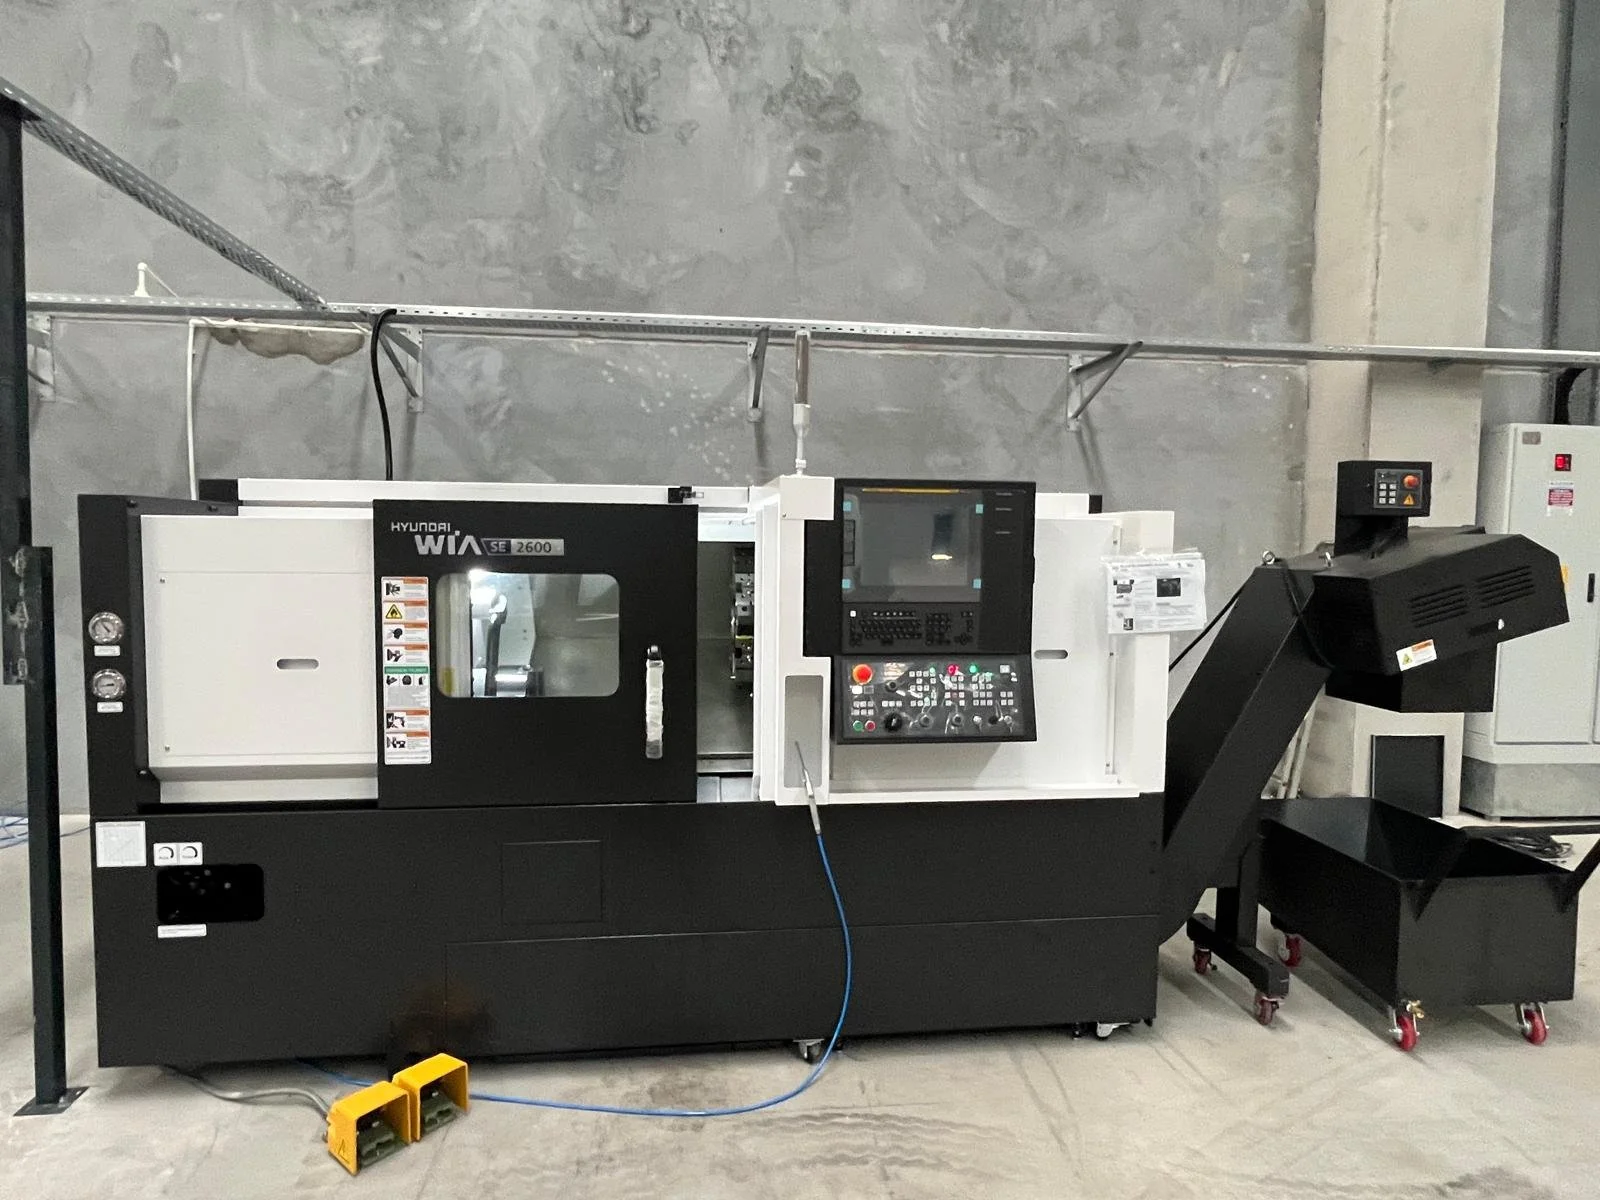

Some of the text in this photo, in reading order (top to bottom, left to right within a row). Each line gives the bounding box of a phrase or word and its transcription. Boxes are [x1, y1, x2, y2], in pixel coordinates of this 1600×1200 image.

[391, 522, 450, 532] HYUNDAI
[490, 541, 506, 552] SE
[517, 541, 552, 553] 2600
